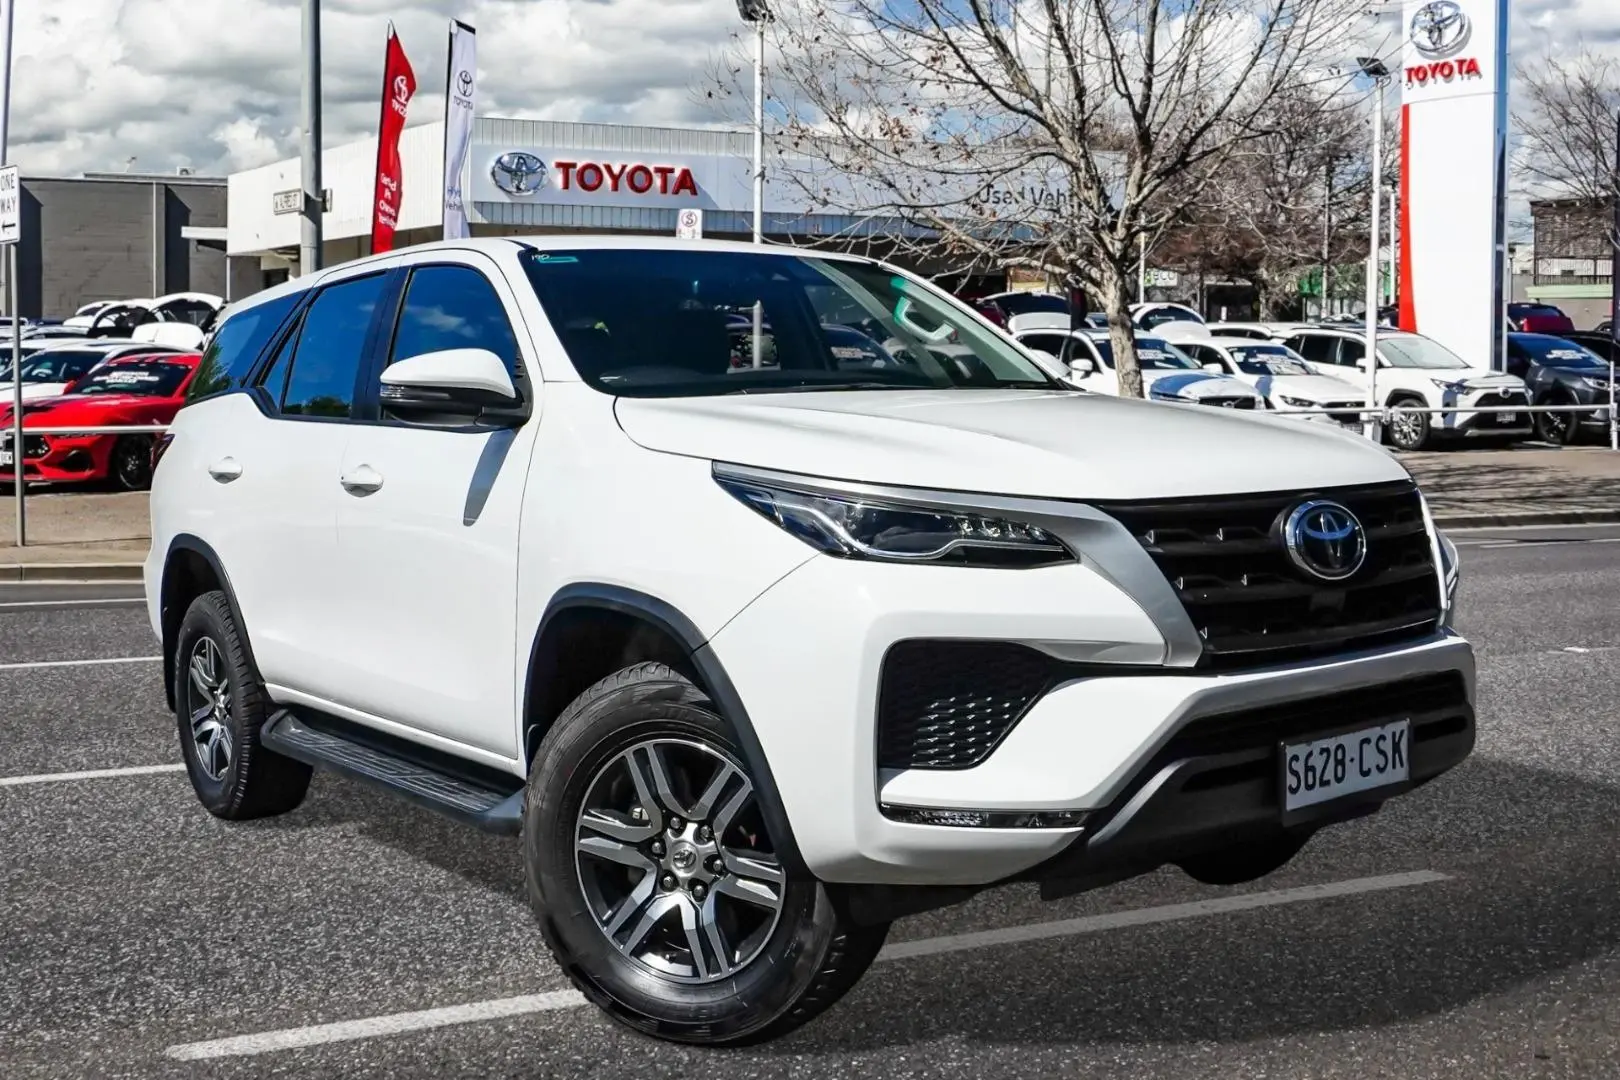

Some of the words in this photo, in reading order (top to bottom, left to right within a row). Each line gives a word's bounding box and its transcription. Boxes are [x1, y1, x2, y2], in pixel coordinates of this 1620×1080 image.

[1404, 58, 1481, 83] TOYOTA
[1, 172, 15, 191] ONE
[554, 161, 698, 196] TOYOTA
[1, 196, 16, 213] WAY
